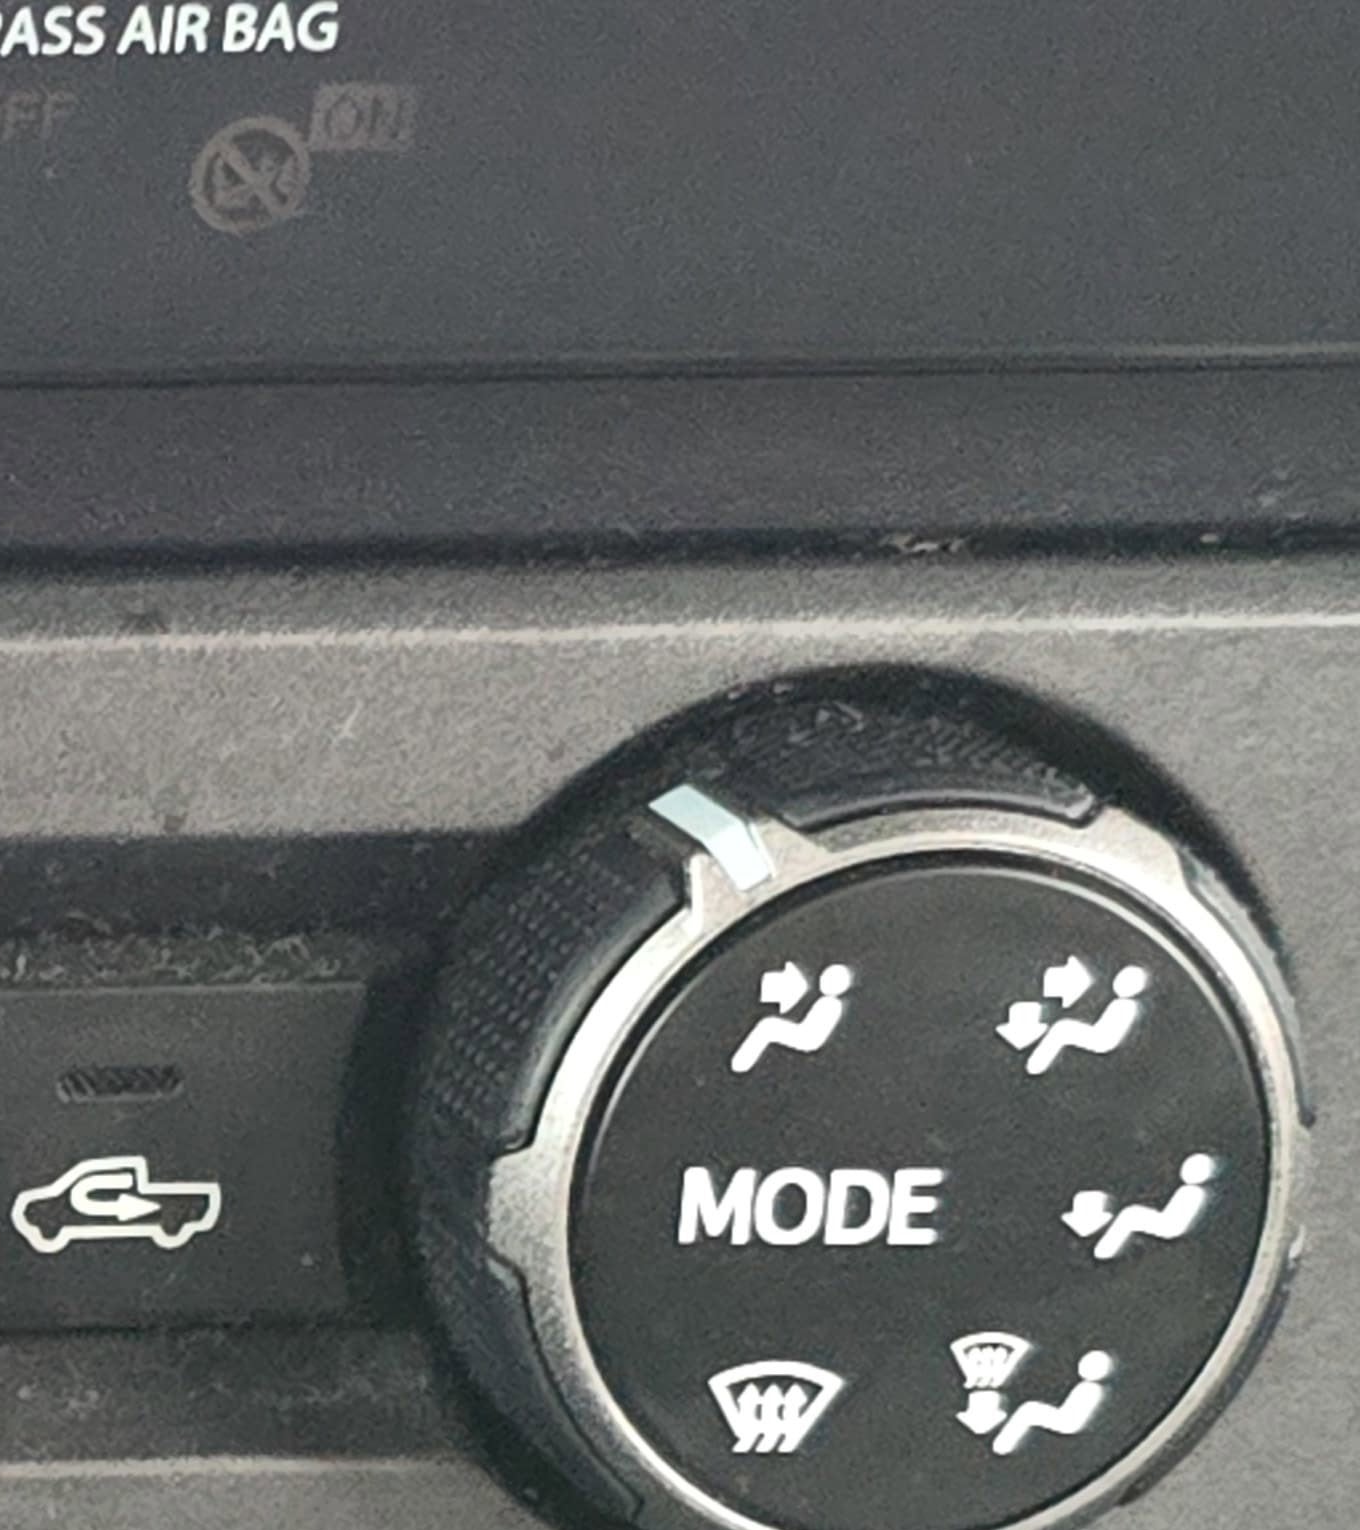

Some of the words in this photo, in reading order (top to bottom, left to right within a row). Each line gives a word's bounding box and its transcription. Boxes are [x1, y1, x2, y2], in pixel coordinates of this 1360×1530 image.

[115, 3, 211, 56] AIR
[221, 0, 340, 53] BAG
[678, 1167, 945, 1245] MODE
